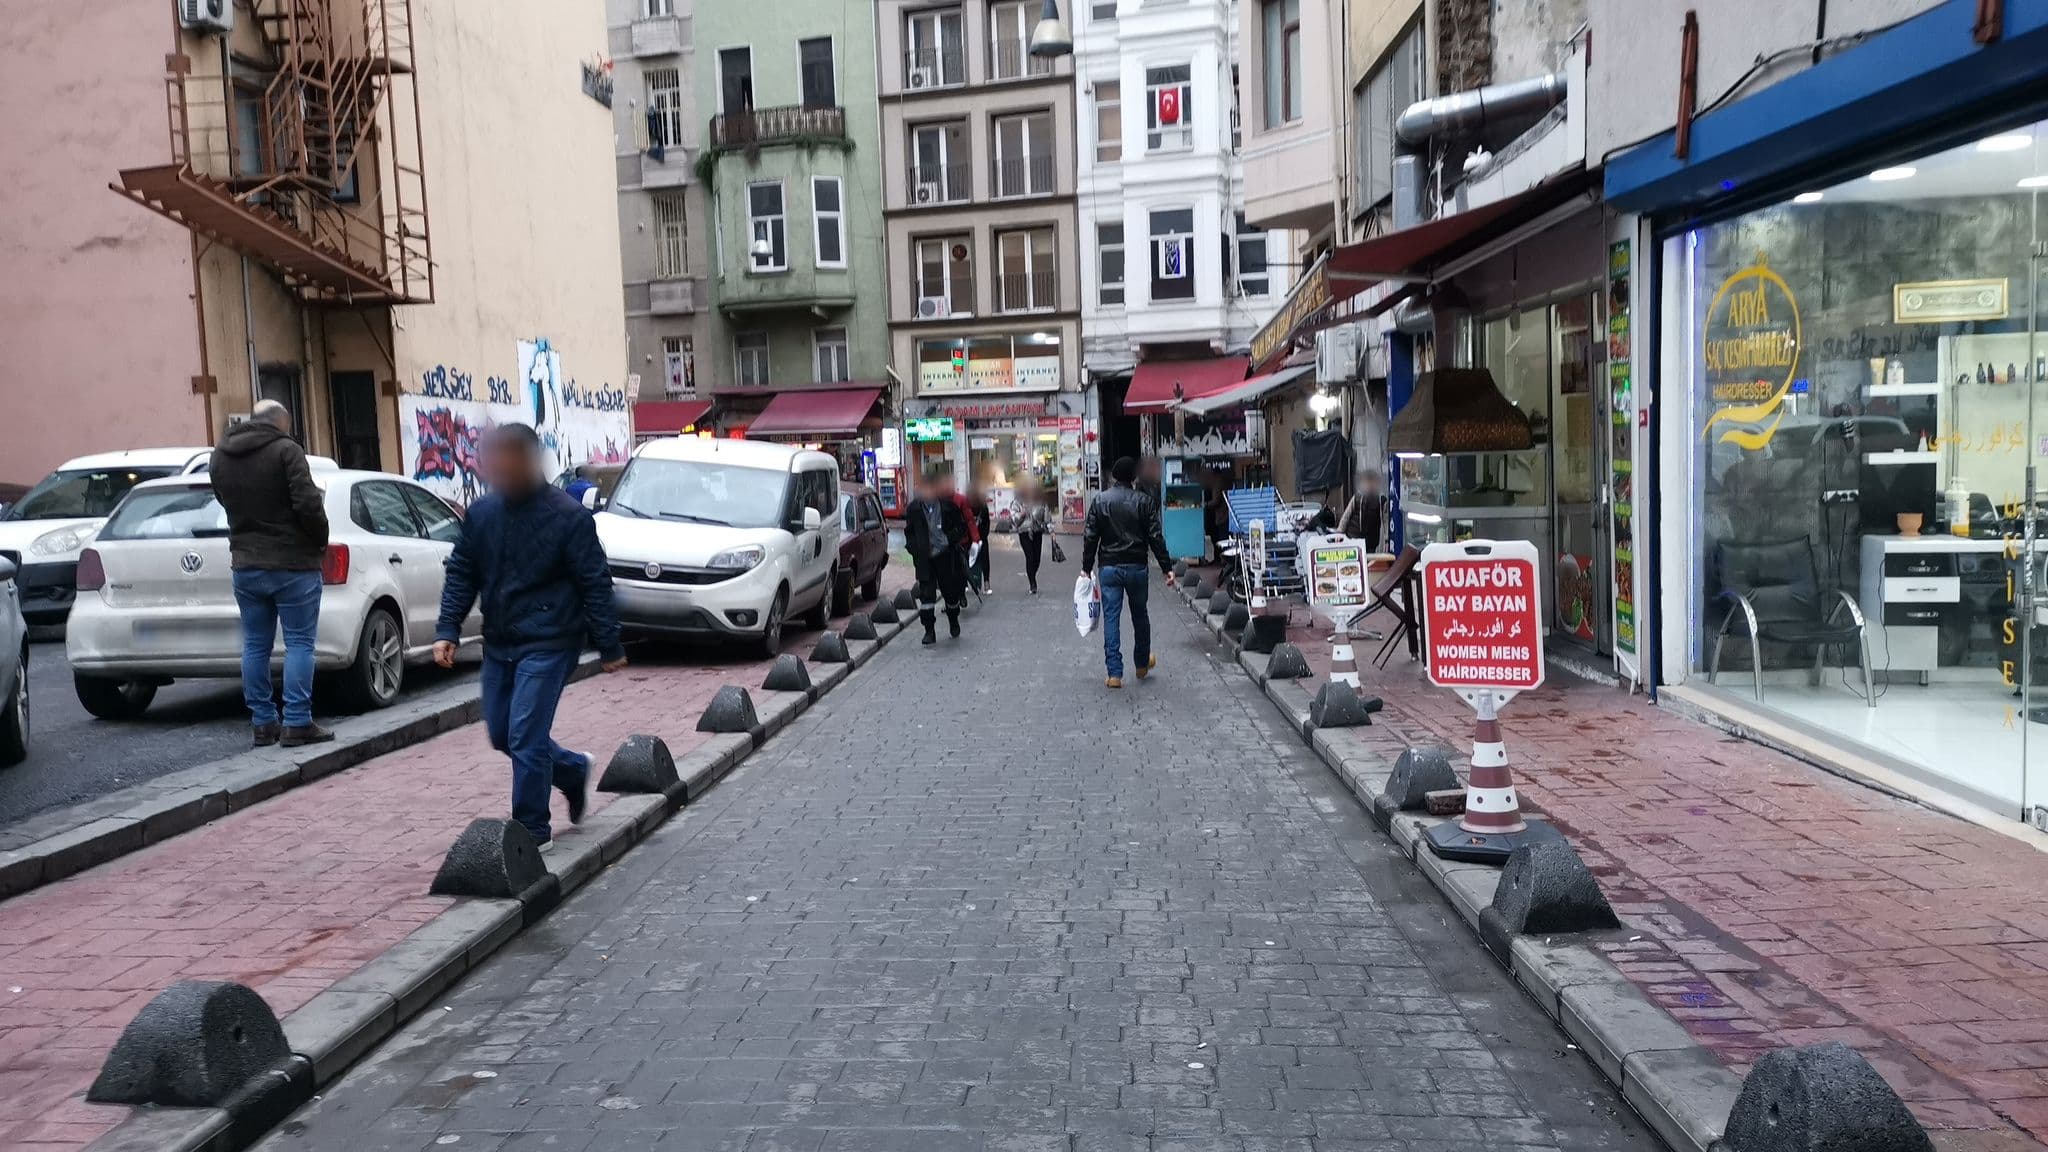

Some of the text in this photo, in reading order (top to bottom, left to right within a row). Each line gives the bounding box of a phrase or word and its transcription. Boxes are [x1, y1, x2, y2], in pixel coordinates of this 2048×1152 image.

[1727, 281, 1769, 328] ARYA
[1435, 563, 1523, 588] KUAFÖR
[1434, 595, 1527, 612] BAY BAYAN
[1436, 645, 1530, 660] WOMEN MENS
